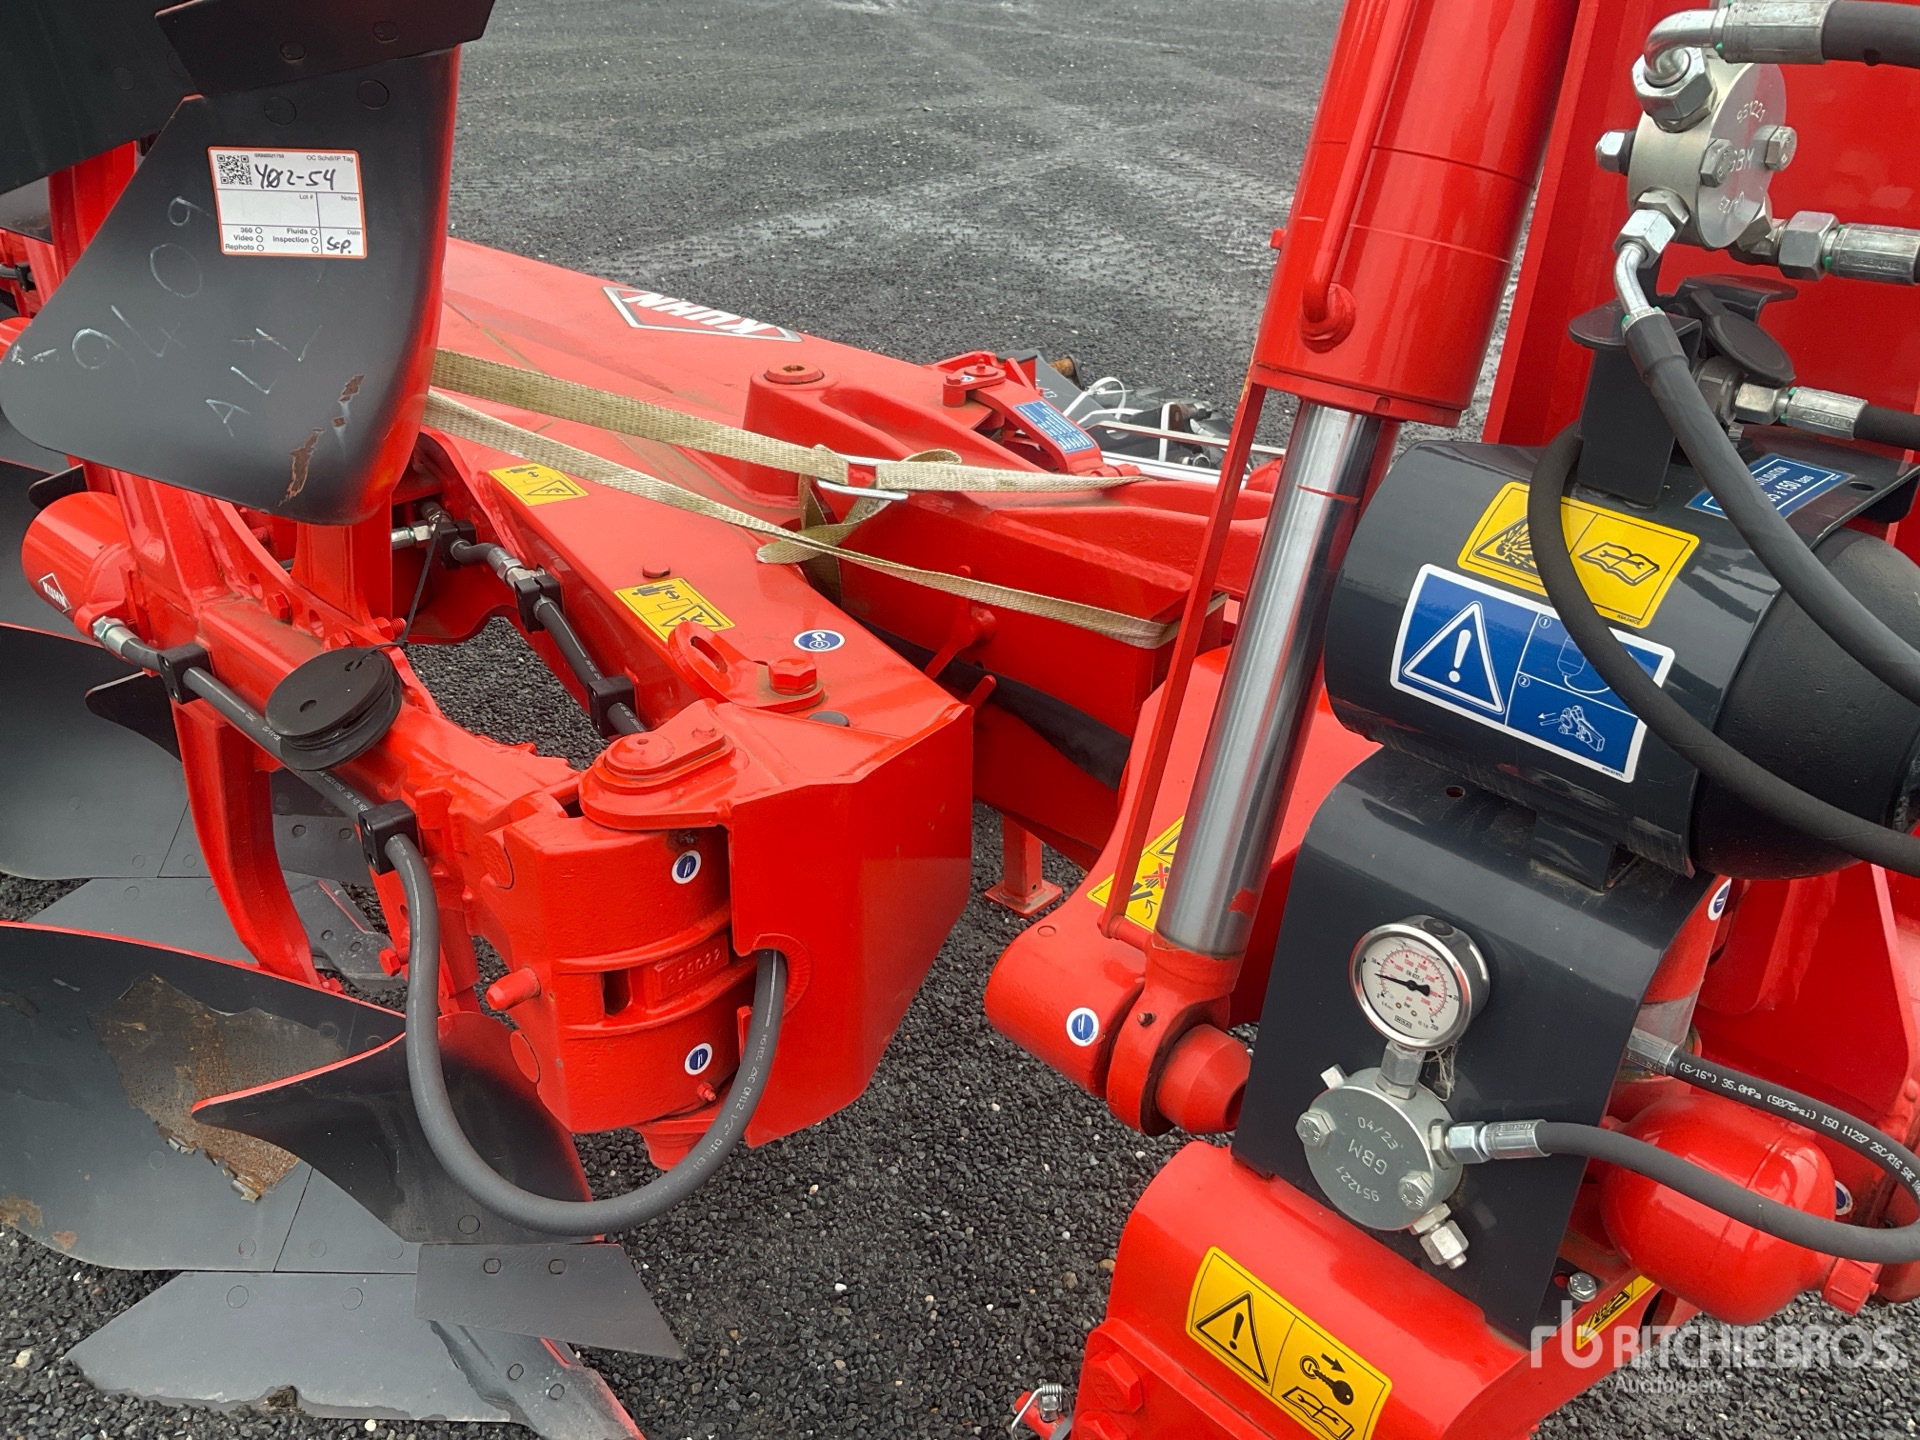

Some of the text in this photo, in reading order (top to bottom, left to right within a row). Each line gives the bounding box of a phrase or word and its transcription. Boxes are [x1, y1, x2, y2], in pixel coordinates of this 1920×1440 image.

[342, 155, 354, 163] Tag
[225, 243, 255, 252] Rephoto
[232, 234, 254, 242] Video
[272, 235, 310, 243] Inspection
[621, 292, 777, 335] KUHN
[1721, 1078, 1762, 1100] 35.0MPa
[1820, 1115, 1840, 1130] ISO
[1841, 1125, 1870, 1144] 11237
[1900, 1166, 1916, 1182] SAE
[1347, 1138, 1388, 1176] GBM
[1335, 1166, 1380, 1202] 951221
